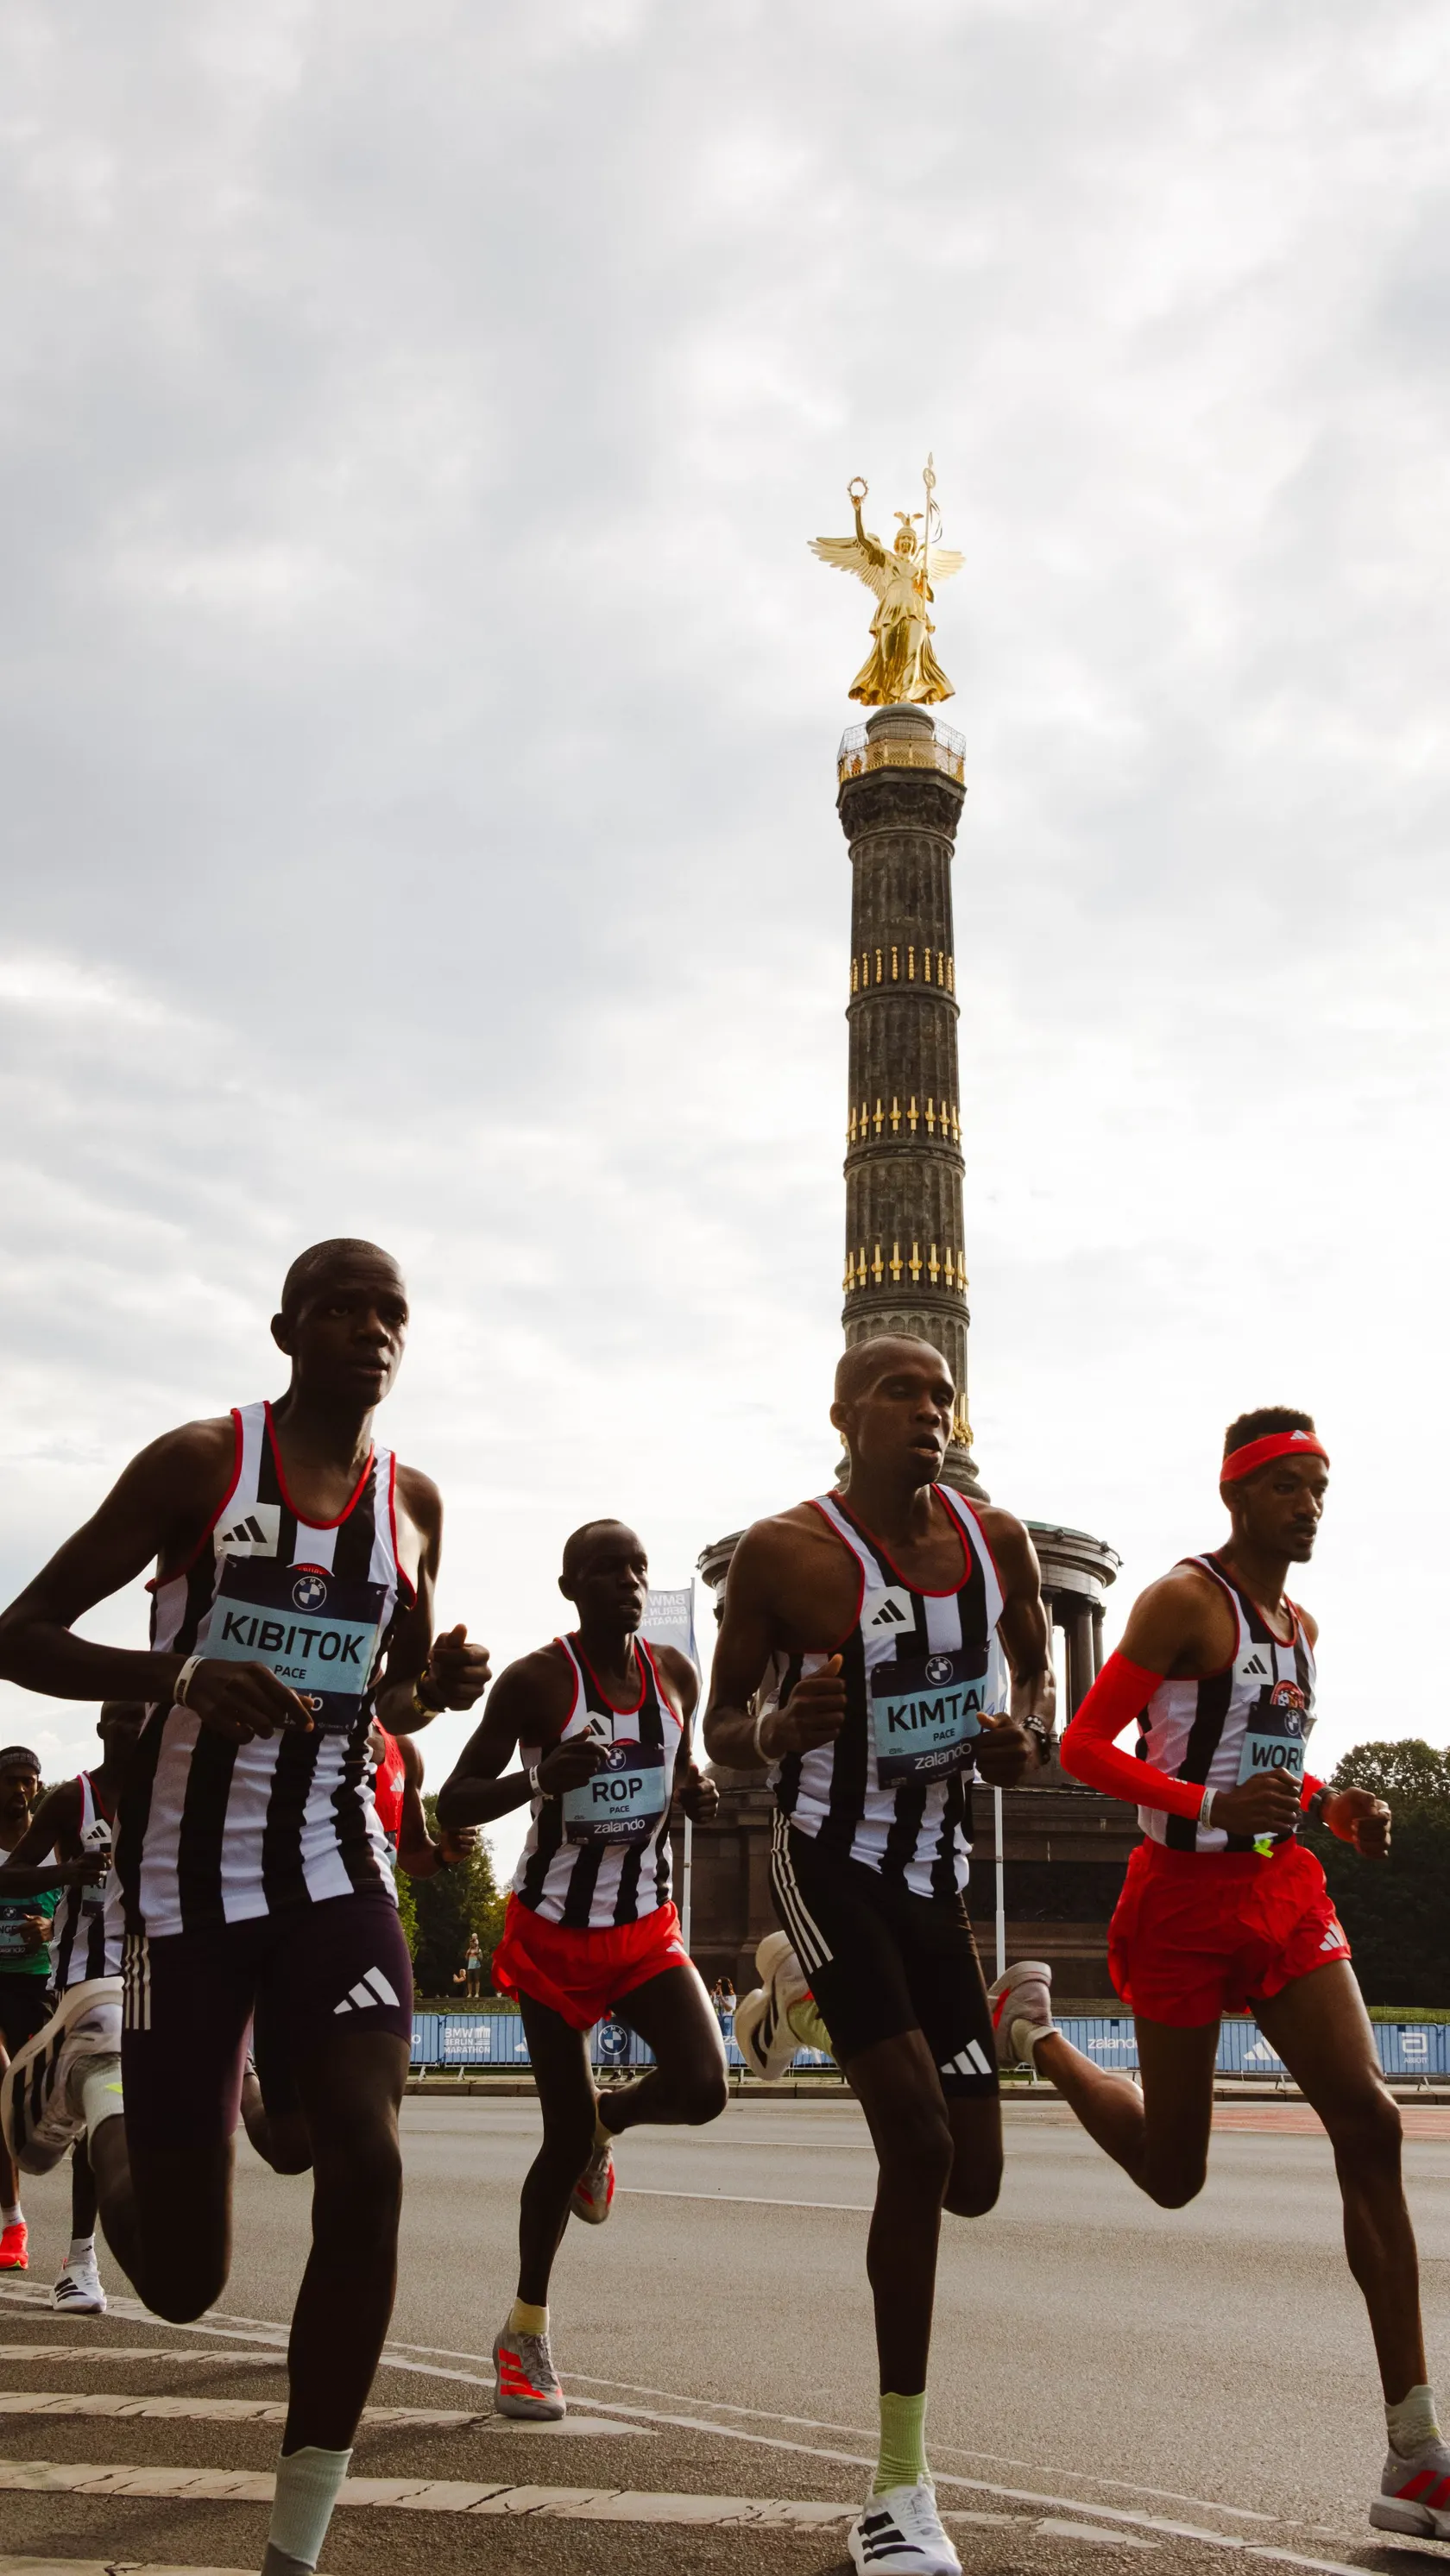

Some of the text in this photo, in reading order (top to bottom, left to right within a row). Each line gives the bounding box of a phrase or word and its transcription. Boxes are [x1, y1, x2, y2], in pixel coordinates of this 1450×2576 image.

[299, 1578, 325, 1590] BMW
[221, 1611, 365, 1665] KIBITOK
[274, 1665, 307, 1679] PACE
[933, 1728, 955, 1741] PACE
[915, 1742, 972, 1770] zalando
[592, 1778, 642, 1803] ROP
[609, 1805, 630, 1814] PACE
[594, 1818, 646, 1834] zalando
[444, 2028, 474, 2038] BMW
